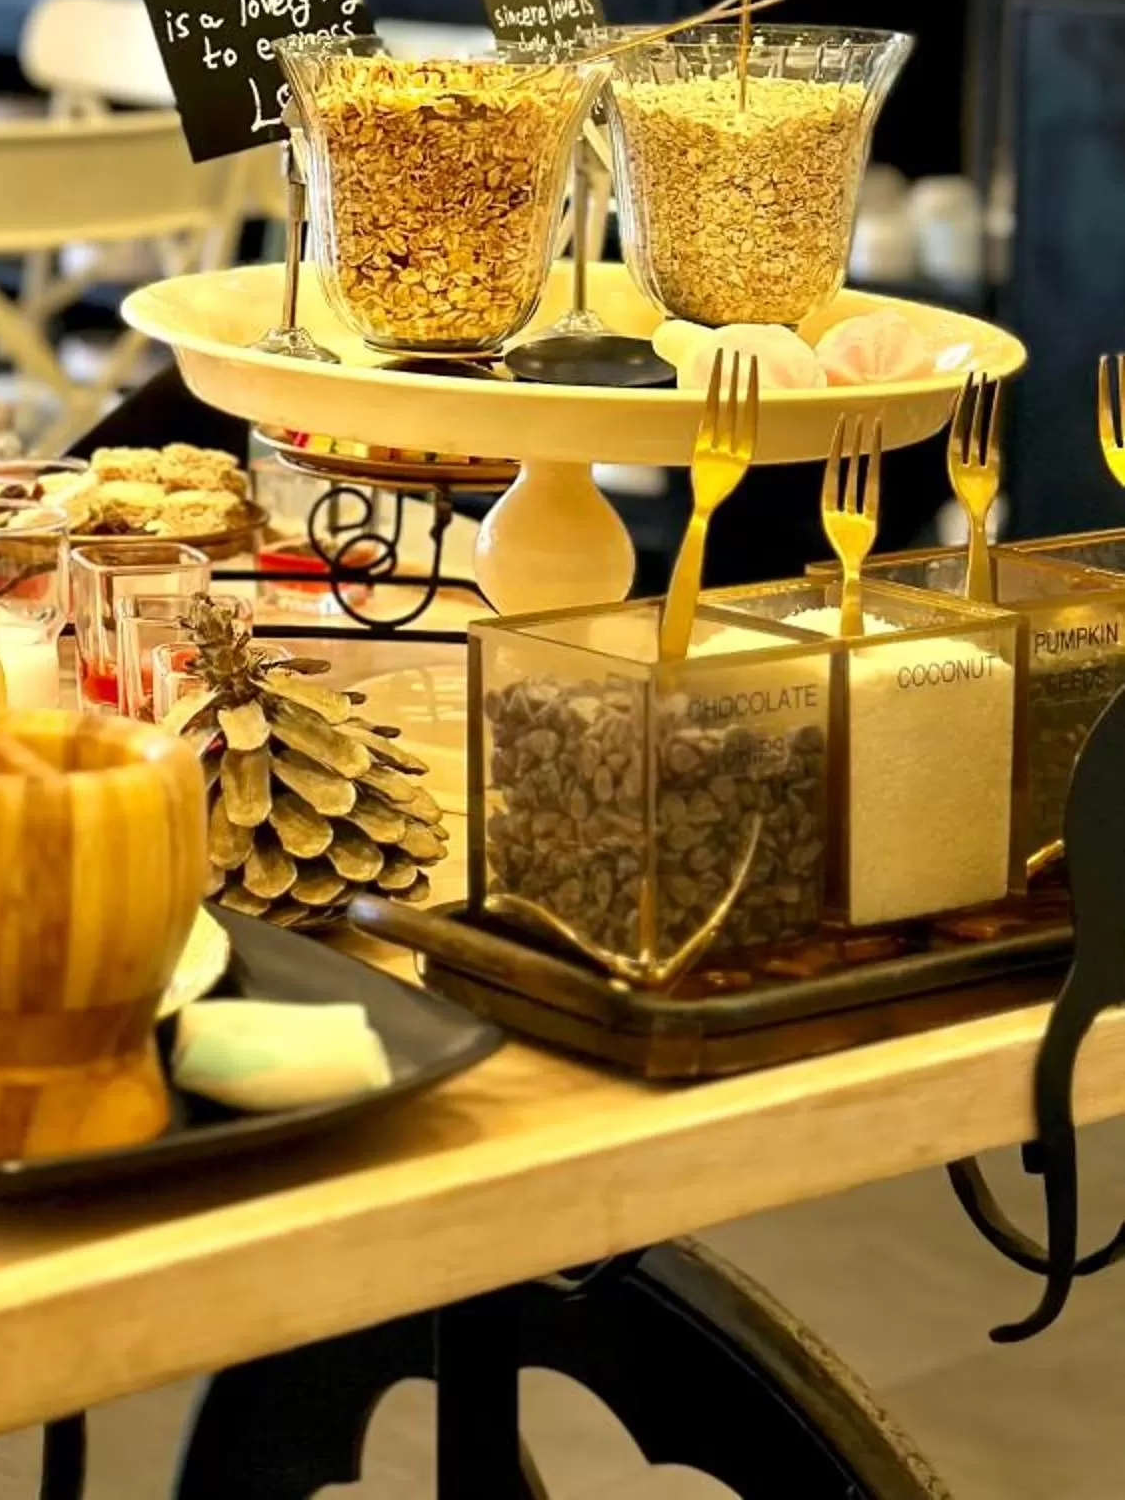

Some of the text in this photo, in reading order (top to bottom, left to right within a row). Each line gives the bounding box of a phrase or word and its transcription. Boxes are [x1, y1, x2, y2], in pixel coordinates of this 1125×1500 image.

[164, 10, 190, 43] is
[199, 13, 224, 29] a
[494, 3, 548, 28] sincere
[202, 36, 238, 69] to
[1034, 621, 1119, 655] PUMPKIN
[896, 655, 996, 690] COCONUT
[687, 683, 818, 722] CHOCOLATE
